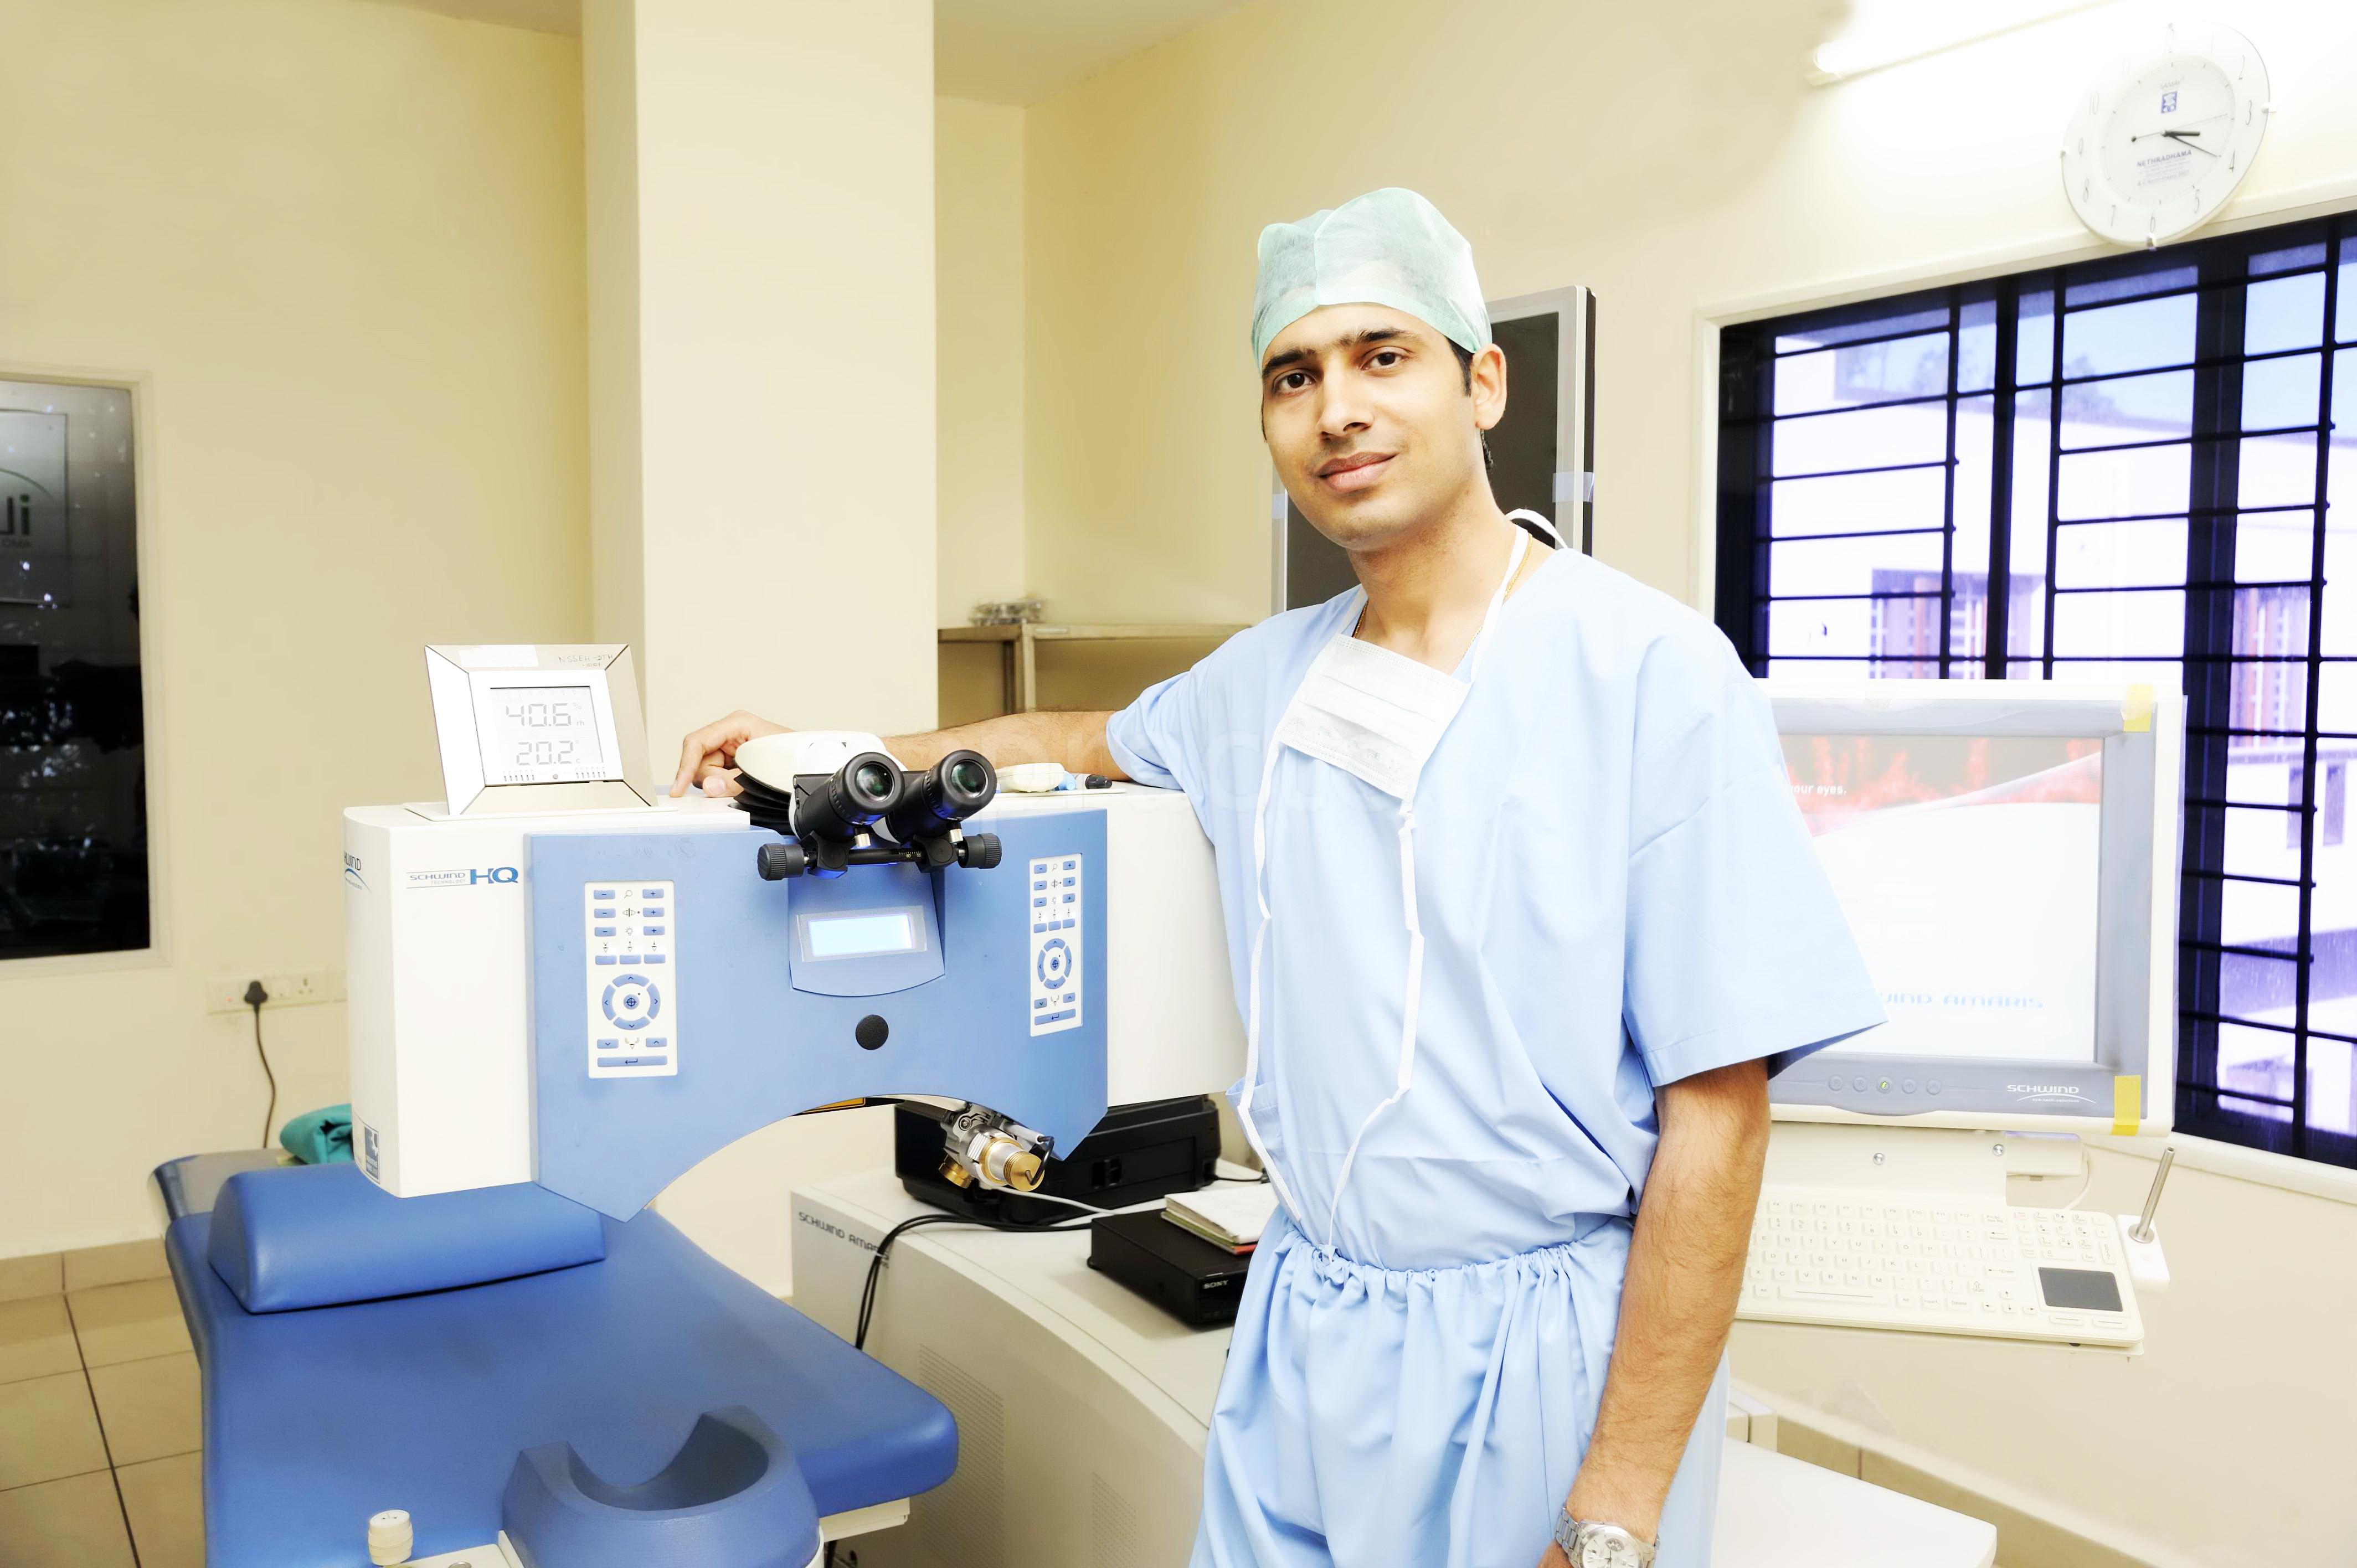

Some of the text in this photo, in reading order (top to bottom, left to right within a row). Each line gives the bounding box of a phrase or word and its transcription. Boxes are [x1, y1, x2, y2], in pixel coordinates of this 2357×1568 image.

[2238, 55, 2245, 80] 2
[2088, 92, 2099, 116] 10
[2245, 100, 2253, 126] 3
[2078, 138, 2084, 161] 9
[2137, 149, 2193, 167] NETHRADHAMA
[2229, 149, 2236, 173] 4
[2083, 179, 2090, 203] 8
[2194, 189, 2200, 213] 5
[2111, 205, 2117, 227] 7
[2149, 211, 2156, 233] 6
[506, 703, 572, 727] 40.6
[517, 740, 573, 765] 20.2
[1817, 785, 1847, 797] eyes.
[409, 866, 519, 885] SCHWIND HQ
[1943, 993, 2044, 1008] AMARIS
[2007, 1085, 2080, 1094] SCHWIND
[799, 1212, 845, 1239] SCHWIND
[1203, 1280, 1228, 1290] SONY
